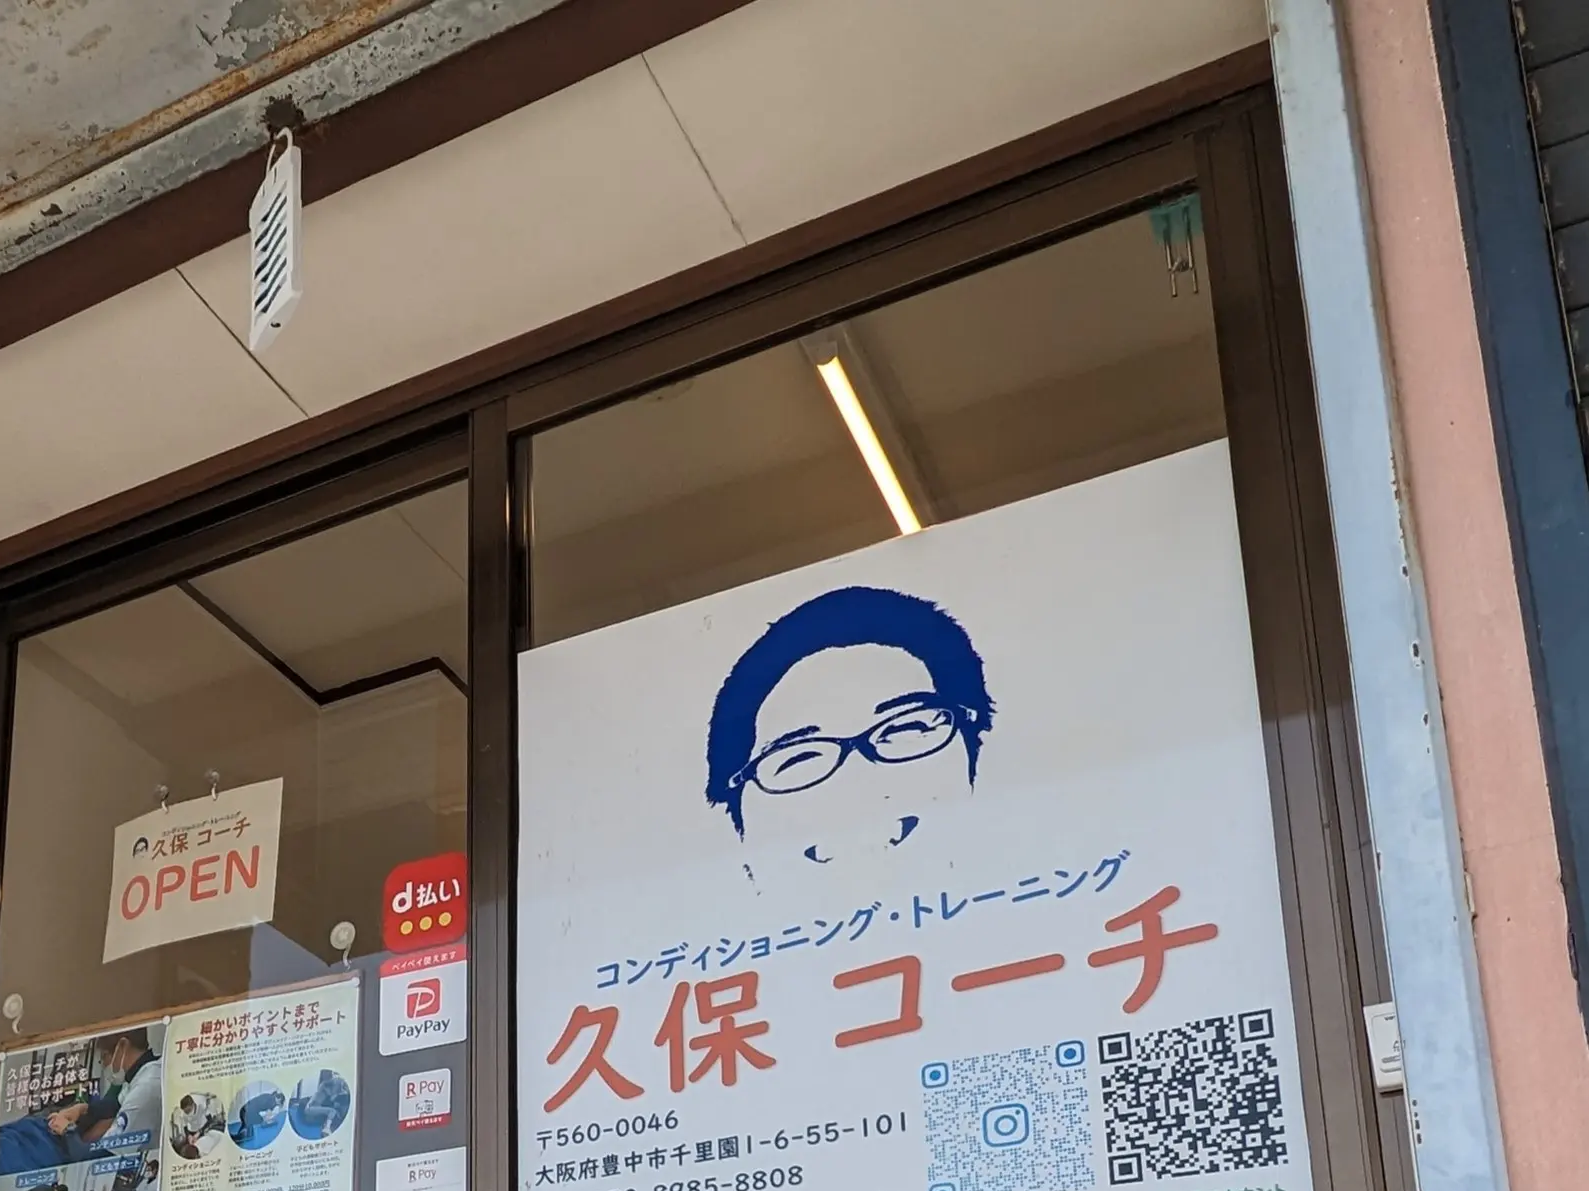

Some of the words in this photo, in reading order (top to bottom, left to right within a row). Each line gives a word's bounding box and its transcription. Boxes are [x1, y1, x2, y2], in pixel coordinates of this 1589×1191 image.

[151, 832, 188, 861] 久保
[196, 816, 252, 847] コーチ
[120, 844, 261, 921] OPEN
[391, 878, 461, 914] d払い
[596, 848, 1131, 989] コンディショニング・トレーニング
[200, 1001, 320, 1035] 細かいポイントまで
[543, 970, 778, 1114] 久保
[832, 884, 1220, 1050] コーチ
[175, 1010, 346, 1054] 丁寧に分かりやすくサポート
[397, 1018, 451, 1040] PayPay
[7, 1053, 80, 1082] 久保コーチが
[419, 1079, 445, 1095] Pay
[535, 1111, 908, 1188] 大阪府豊中市千里園1-6-55-101
[536, 1110, 680, 1151] 〒560-0046
[418, 1168, 437, 1181] Pay
